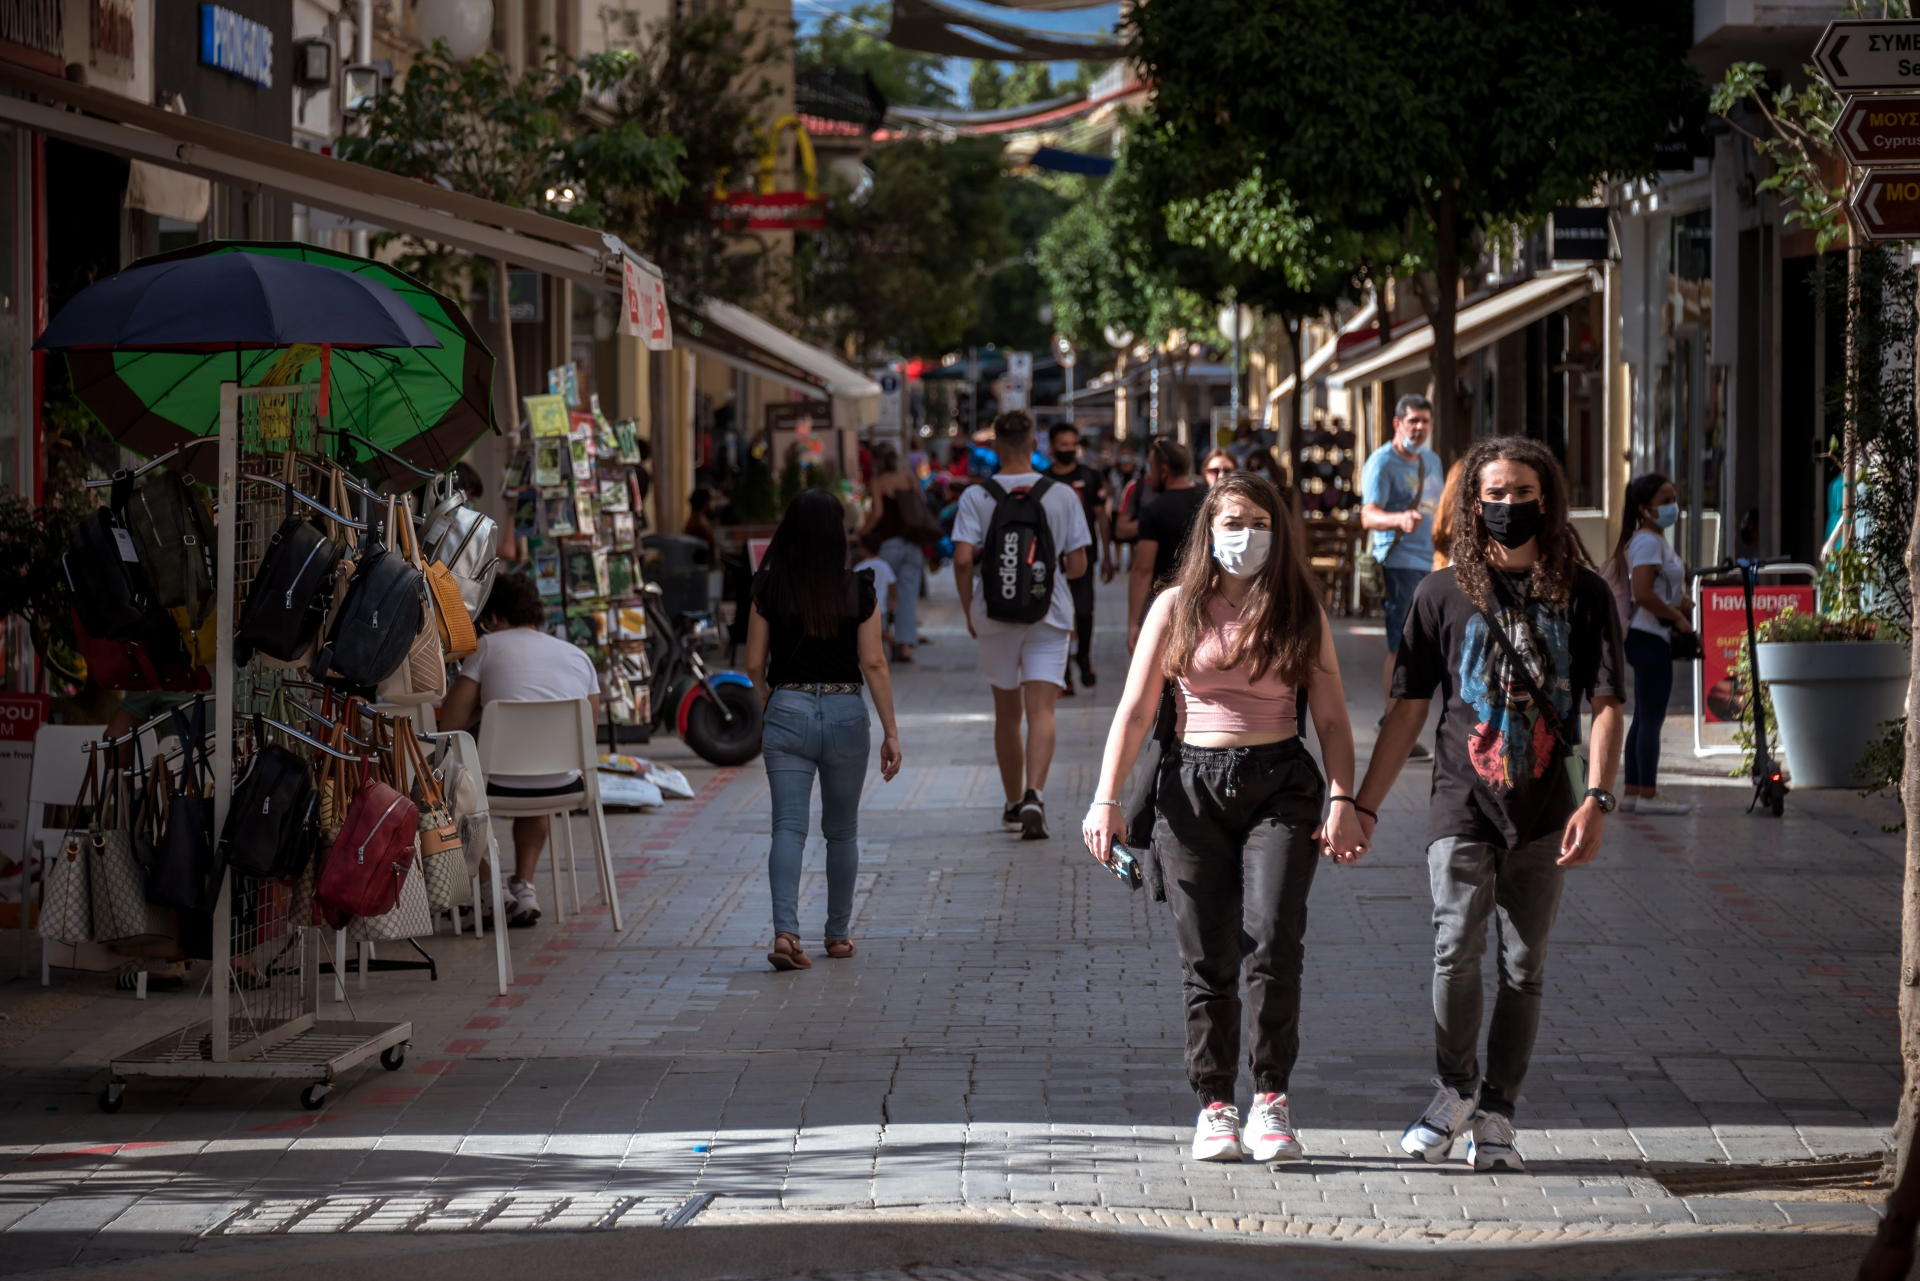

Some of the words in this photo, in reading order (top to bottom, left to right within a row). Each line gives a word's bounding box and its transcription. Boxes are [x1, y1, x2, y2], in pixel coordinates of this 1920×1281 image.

[1869, 112, 1920, 127] ΜΟΥΣ
[1886, 182, 1920, 201] ΜΟ
[1555, 227, 1608, 240] DIESEL
[999, 532, 1019, 599] adidas
